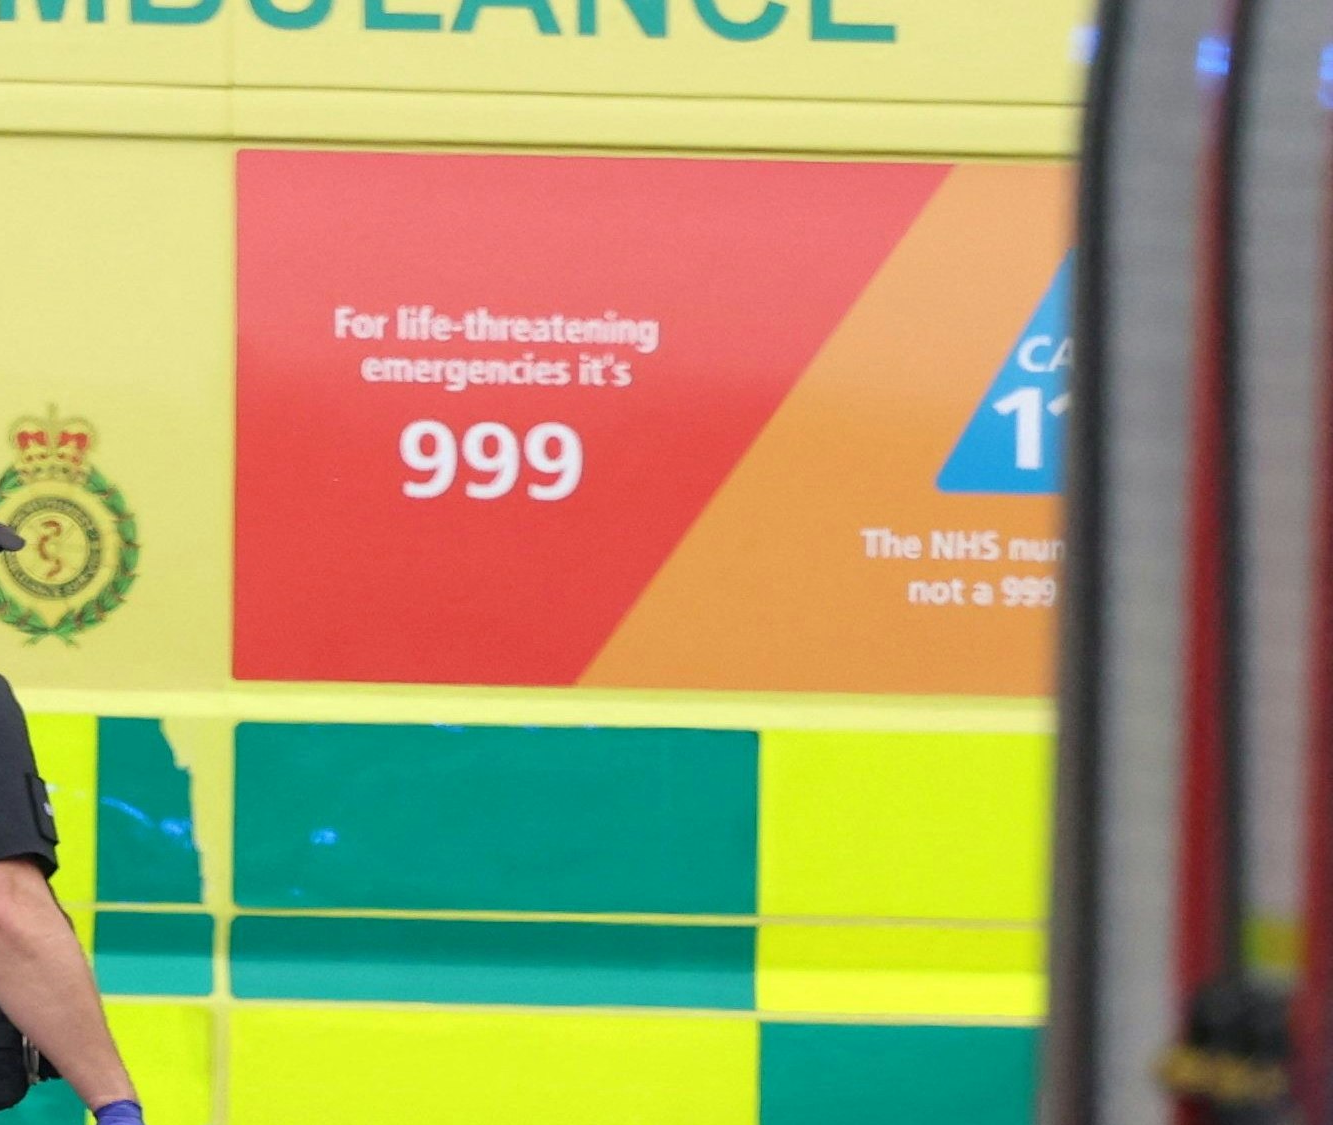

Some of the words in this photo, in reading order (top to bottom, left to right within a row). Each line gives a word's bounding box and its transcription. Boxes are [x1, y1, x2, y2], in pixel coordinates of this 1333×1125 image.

[335, 306, 389, 340] For
[396, 305, 660, 353] life-threatening
[360, 353, 571, 392] emergencies
[579, 353, 632, 387] it's
[1017, 335, 1074, 374] CA
[399, 419, 584, 501] 999
[861, 528, 923, 560] The
[931, 530, 1001, 561] NHS
[908, 578, 965, 604] not
[971, 581, 994, 605] a
[1001, 575, 1056, 607] 999
